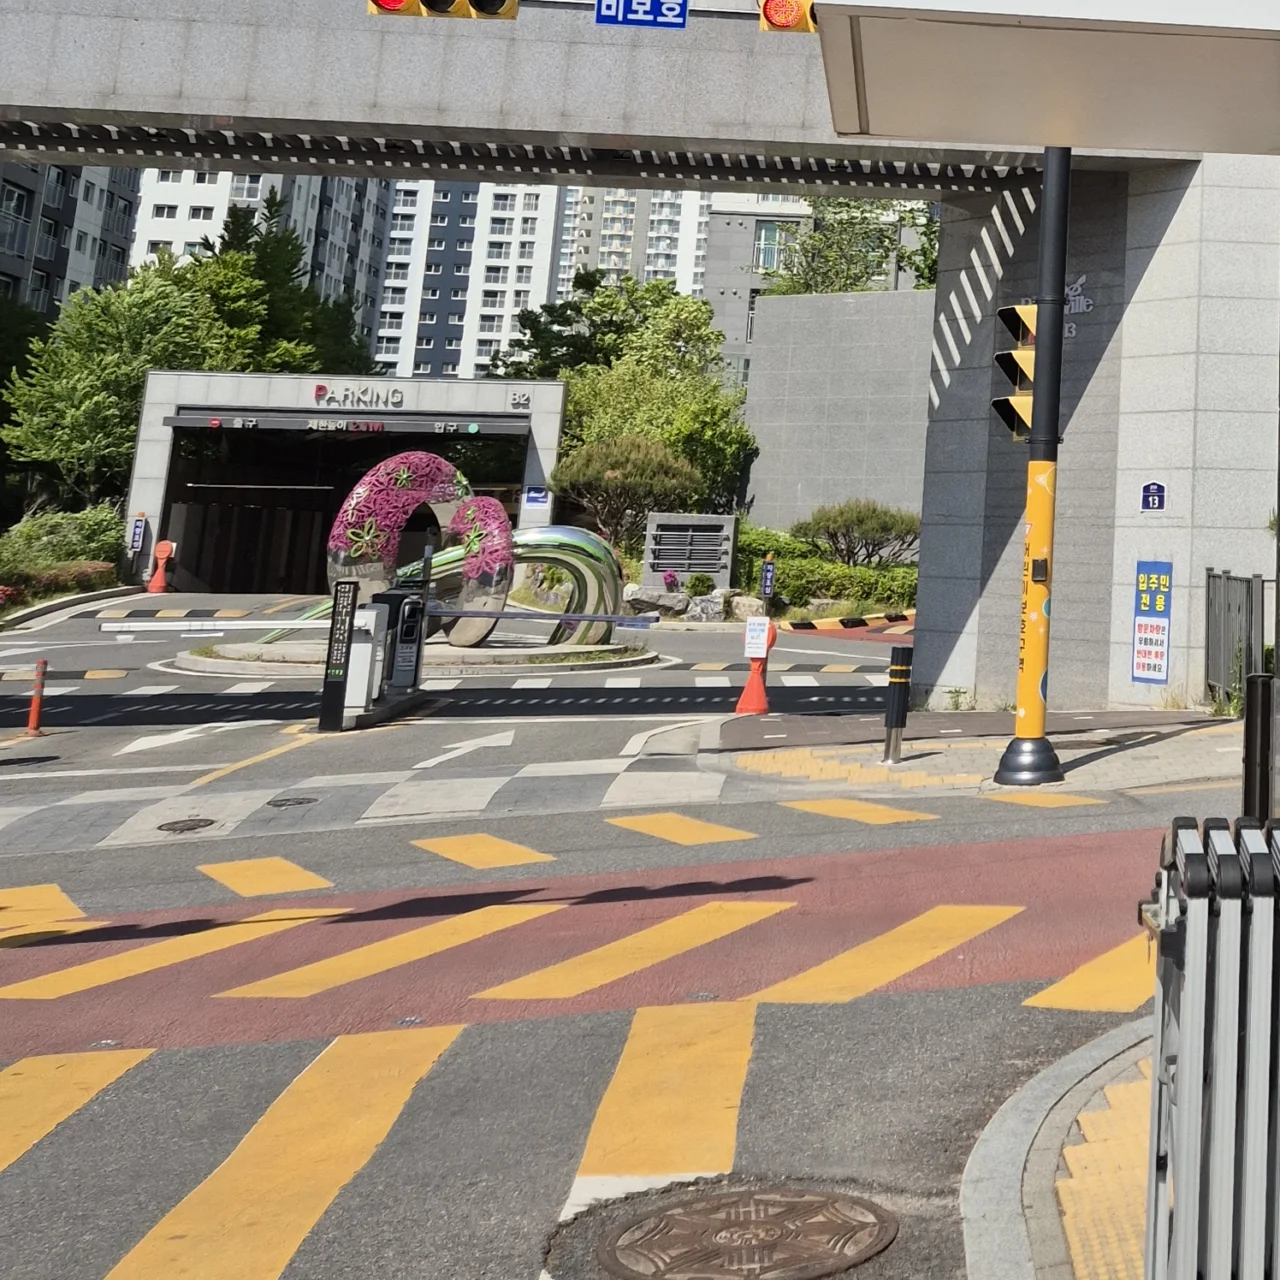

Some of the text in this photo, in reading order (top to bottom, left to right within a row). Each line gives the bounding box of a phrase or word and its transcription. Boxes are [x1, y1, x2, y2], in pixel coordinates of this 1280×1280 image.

[314, 384, 404, 408] PARKING
[511, 391, 530, 409] B2
[233, 417, 257, 429] 출구
[434, 421, 458, 434] 입구
[1148, 495, 1159, 508] 13
[1138, 573, 1169, 592] 입주민
